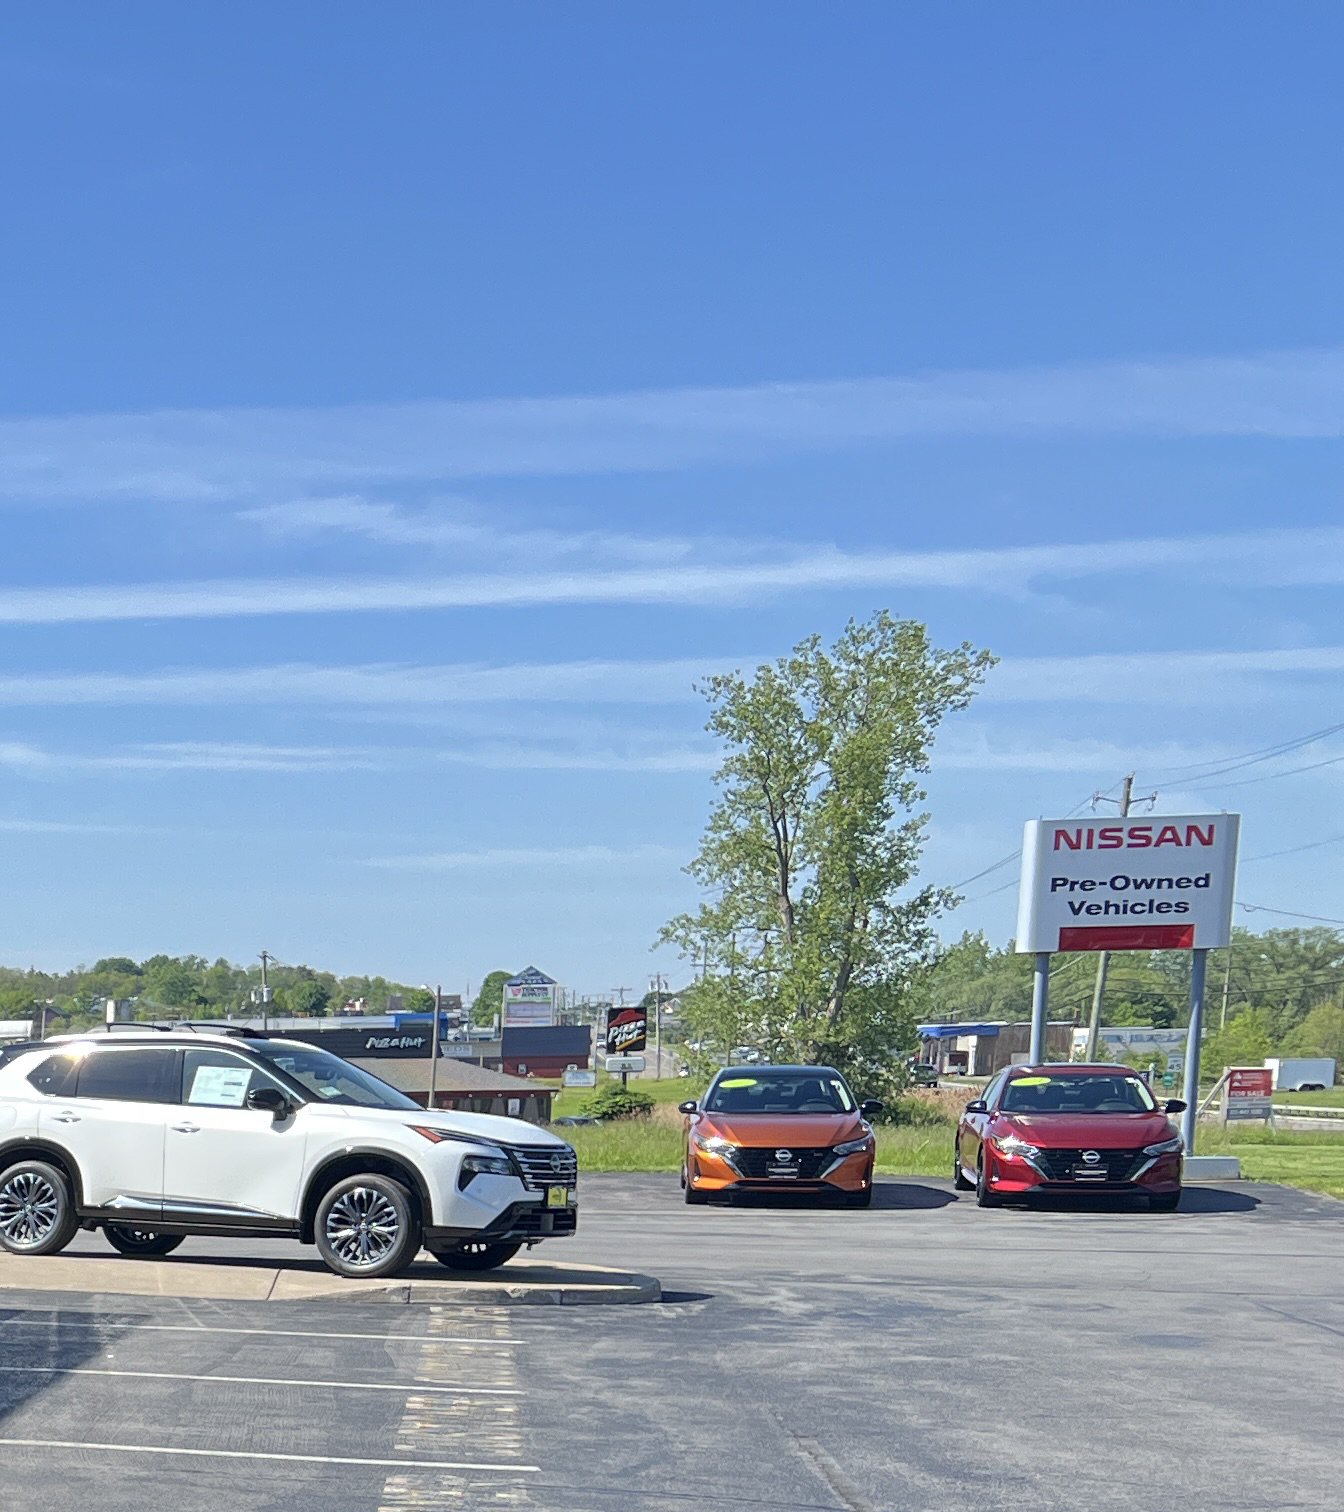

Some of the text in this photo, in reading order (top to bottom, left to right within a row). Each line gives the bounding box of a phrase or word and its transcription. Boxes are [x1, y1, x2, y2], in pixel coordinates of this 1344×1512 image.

[1053, 824, 1215, 850] NISSAN
[1050, 873, 1210, 892] Pre-Owned
[1068, 899, 1190, 916] Vehicles
[1168, 1063, 1181, 1071] 45
